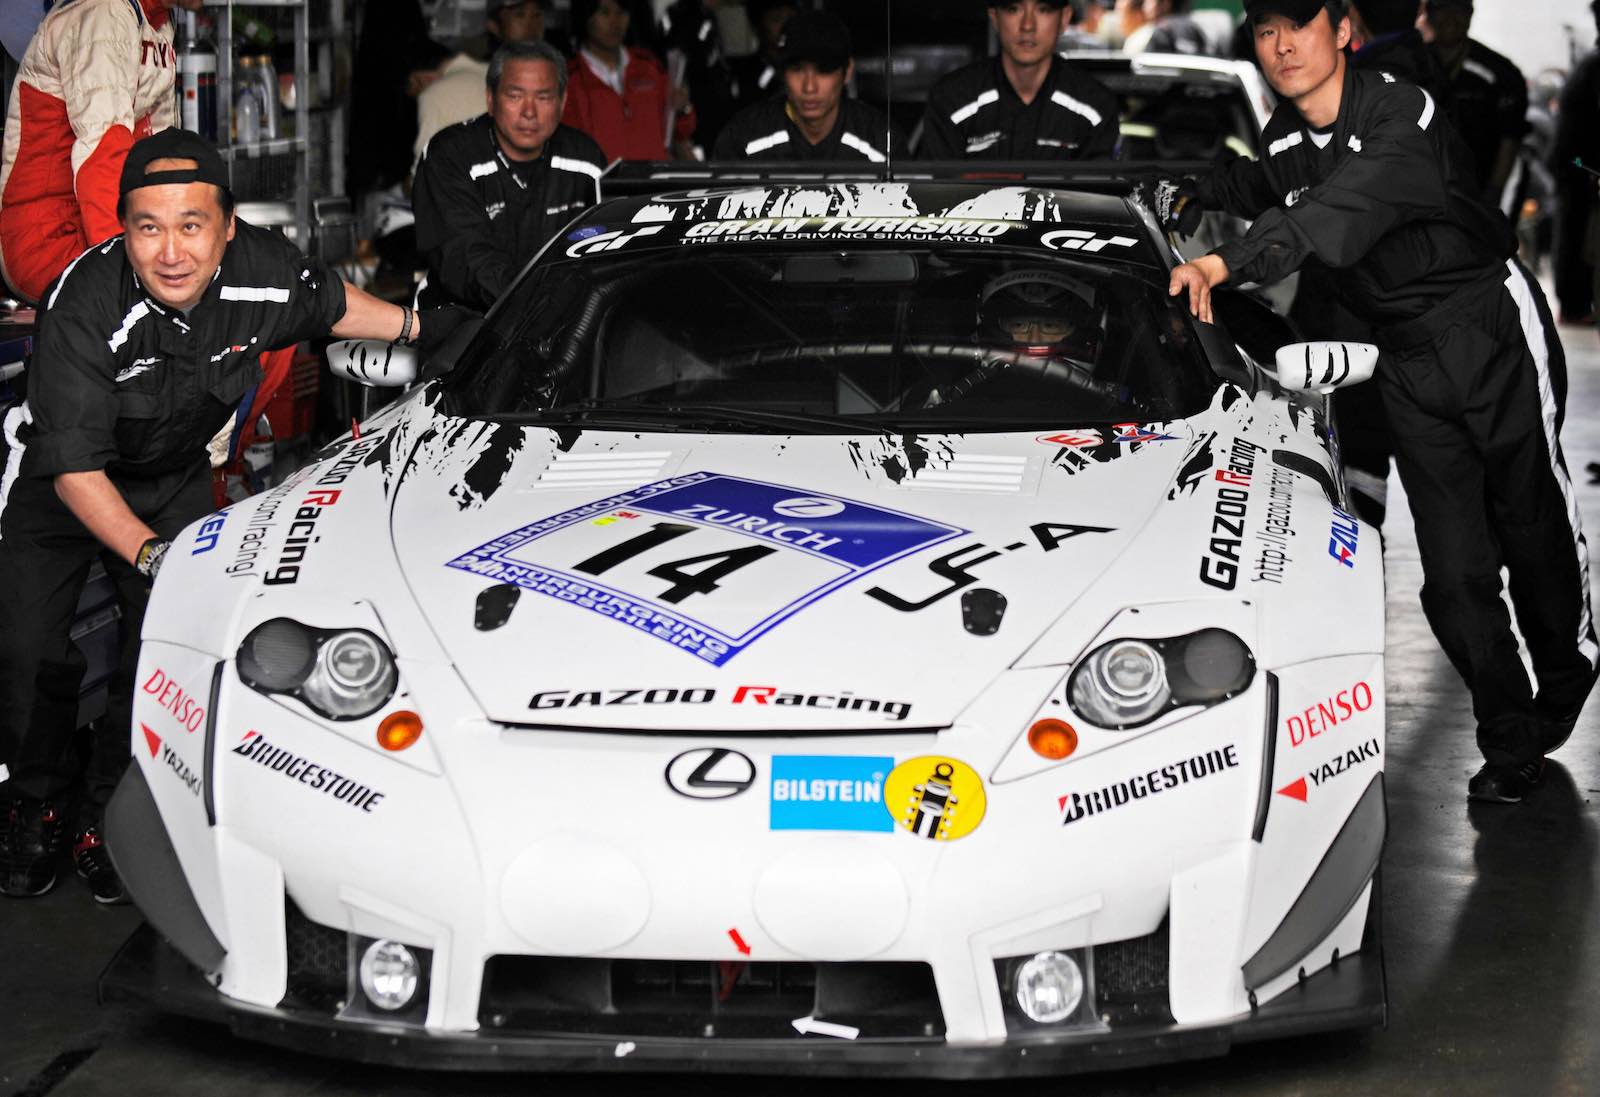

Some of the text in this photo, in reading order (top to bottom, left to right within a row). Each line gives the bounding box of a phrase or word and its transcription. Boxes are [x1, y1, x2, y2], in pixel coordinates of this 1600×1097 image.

[680, 232, 994, 245] THE REAL DRIVING SIMULATOR
[684, 216, 1010, 239] GRAN TURISMO
[264, 489, 343, 586] Racing
[672, 503, 843, 551] ZURICH
[1200, 437, 1267, 591] GAZOO Racing
[571, 522, 779, 605] 14
[142, 668, 205, 734] DENSO
[527, 686, 913, 721] GAZOO Racing
[1287, 681, 1372, 748] DENSO
[161, 744, 203, 797] YAZAKI
[232, 730, 387, 814] BRIDGESTONE
[772, 777, 882, 803] BILSTEIN
[1057, 744, 1240, 826] BRIDGESTONE
[1309, 738, 1381, 787] YAZAKI
